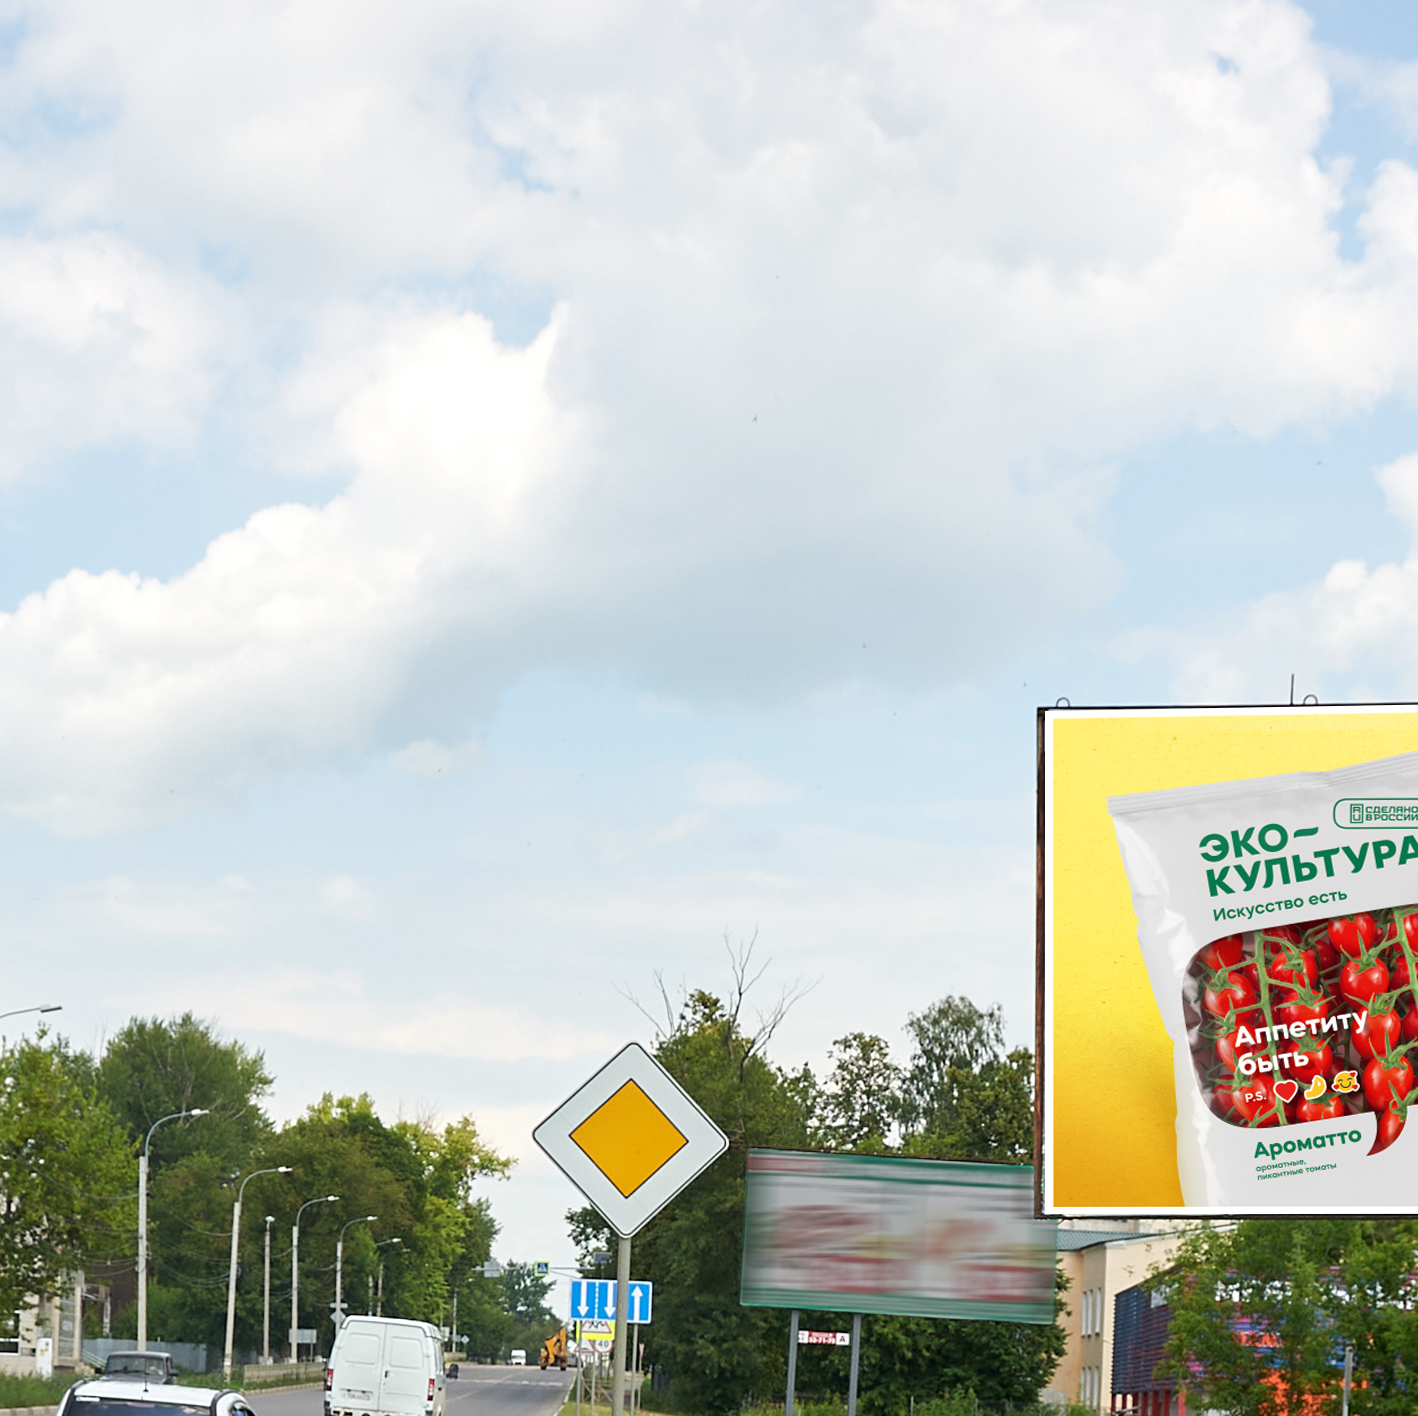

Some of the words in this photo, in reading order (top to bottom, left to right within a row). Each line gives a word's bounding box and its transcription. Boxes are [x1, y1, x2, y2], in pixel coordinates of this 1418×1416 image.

[1365, 806, 1418, 814] СДЕЛАНО
[1213, 897, 1304, 921] Искусство
[1308, 890, 1348, 905] есть
[1235, 1010, 1368, 1048] Аппетиту
[1238, 1051, 1309, 1075] быть
[1244, 1091, 1267, 1103] P.S.
[1254, 1130, 1362, 1160] Ароматто
[1255, 1159, 1307, 1173] ароматные,
[1257, 1168, 1304, 1181] пикантные
[1305, 1163, 1337, 1173] томаты
[598, 1341, 609, 1349] 40
